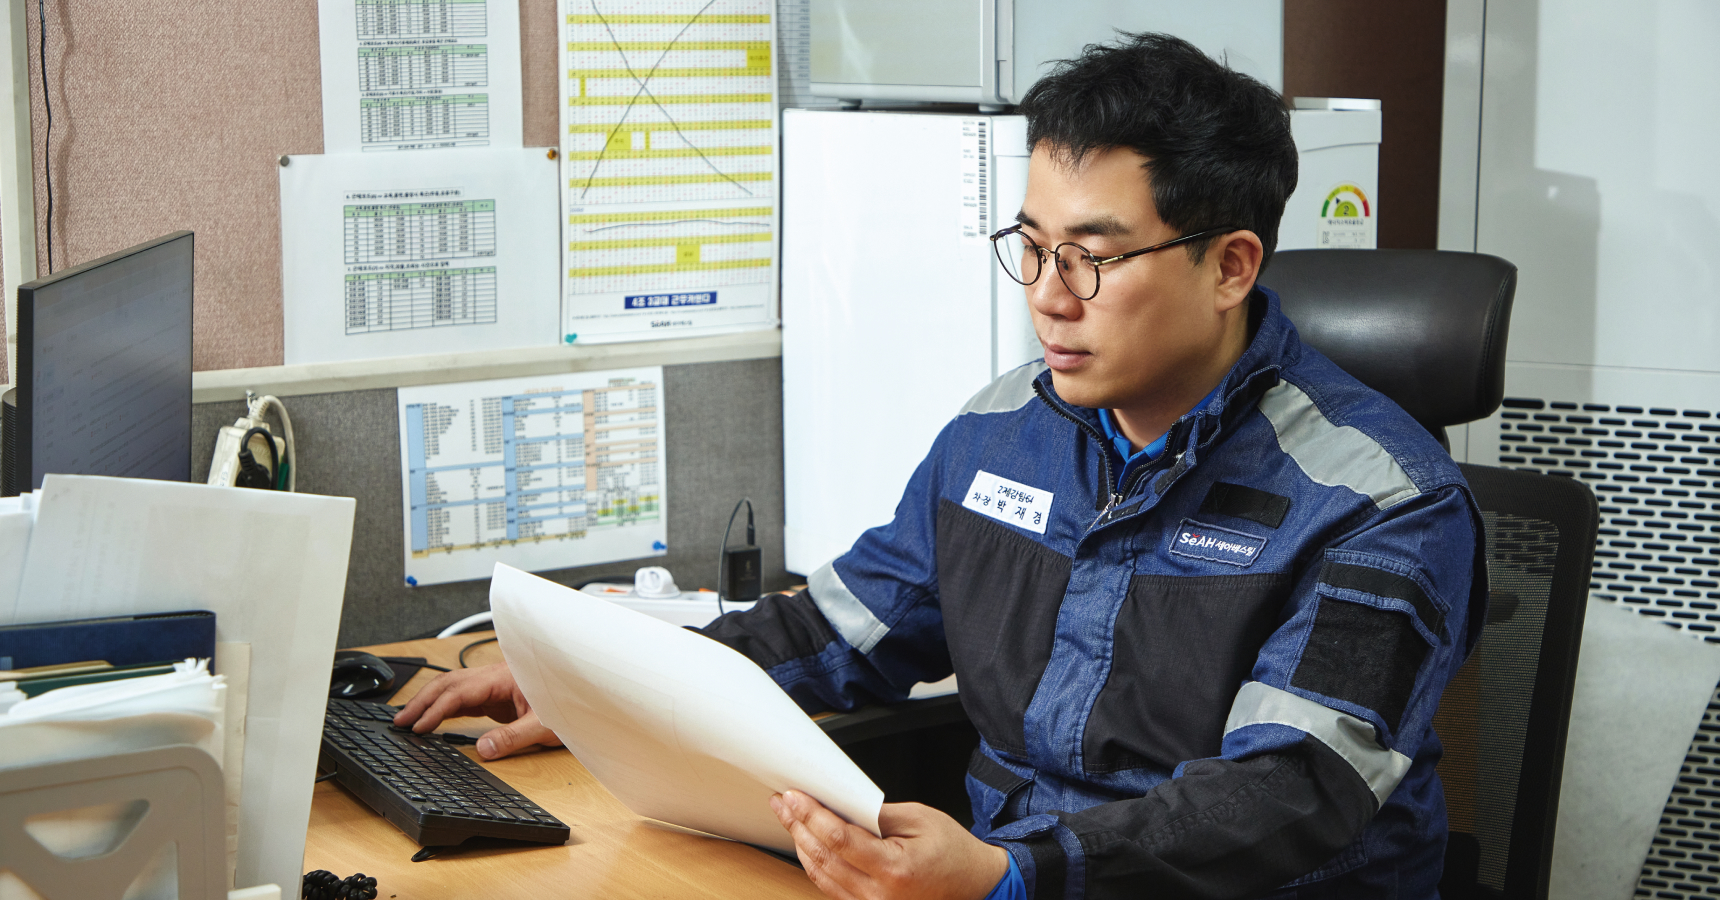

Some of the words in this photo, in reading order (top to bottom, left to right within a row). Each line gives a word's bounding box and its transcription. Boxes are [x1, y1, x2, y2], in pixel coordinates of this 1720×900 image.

[973, 491, 991, 506] 차장
[1033, 511, 1042, 525] 경
[1215, 540, 1256, 557] 세아베스틸
